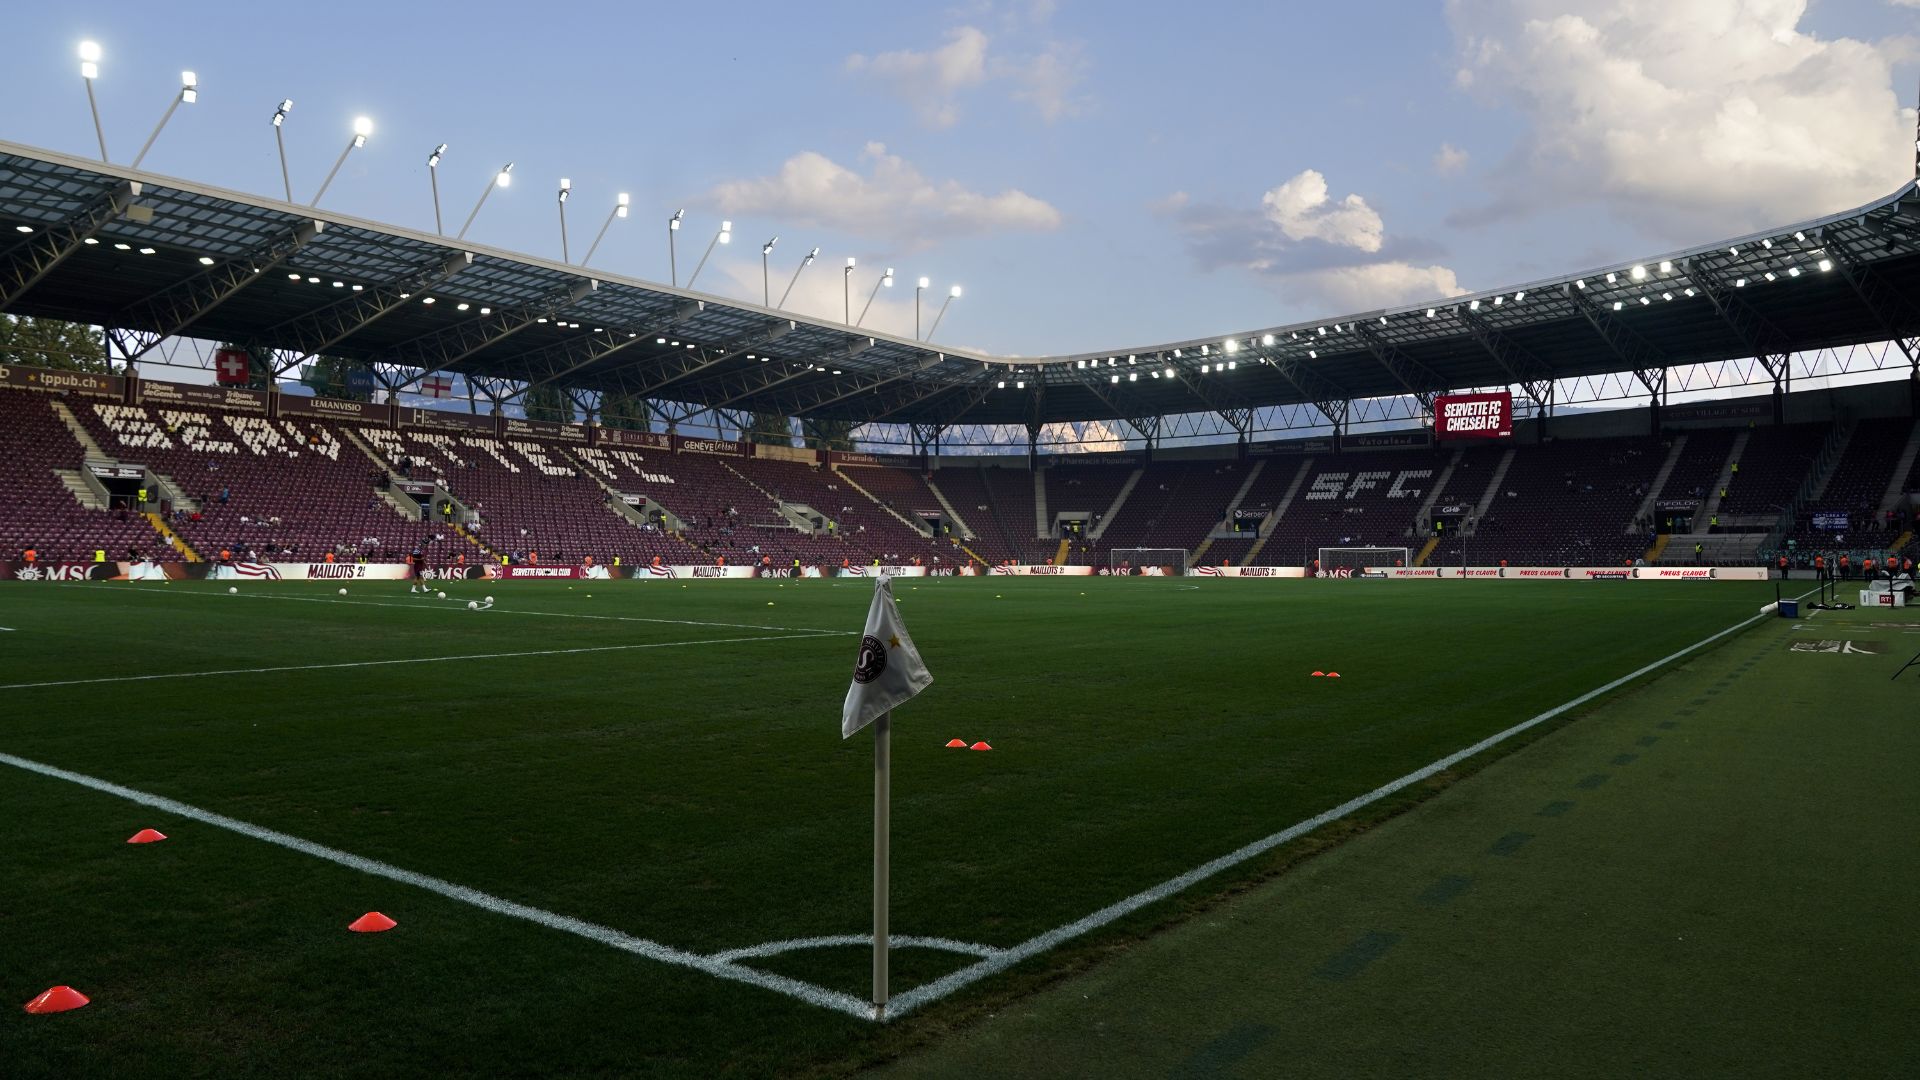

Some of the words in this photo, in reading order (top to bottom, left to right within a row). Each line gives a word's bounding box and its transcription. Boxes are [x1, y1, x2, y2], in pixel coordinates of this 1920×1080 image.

[40, 372, 97, 388] tppub.ch
[144, 382, 174, 391] Tribune
[226, 391, 254, 399] Tribune
[1444, 401, 1489, 417] SERVETTE
[1489, 400, 1502, 415] FC
[1447, 415, 1486, 431] CHELSEA
[1487, 415, 1500, 430] FC
[1062, 457, 1100, 465] Pharmacie
[1102, 456, 1137, 465] Populaire
[1305, 470, 1433, 500] SFC
[307, 564, 355, 579] MAILLOTS
[512, 567, 536, 577] SERVETTE
[536, 567, 557, 577] FOOTBALL
[557, 567, 571, 577] CLUB
[692, 566, 721, 577] MAILLOTS
[1029, 566, 1058, 575] MAILLOTS
[1240, 567, 1270, 577] MAILLOTS
